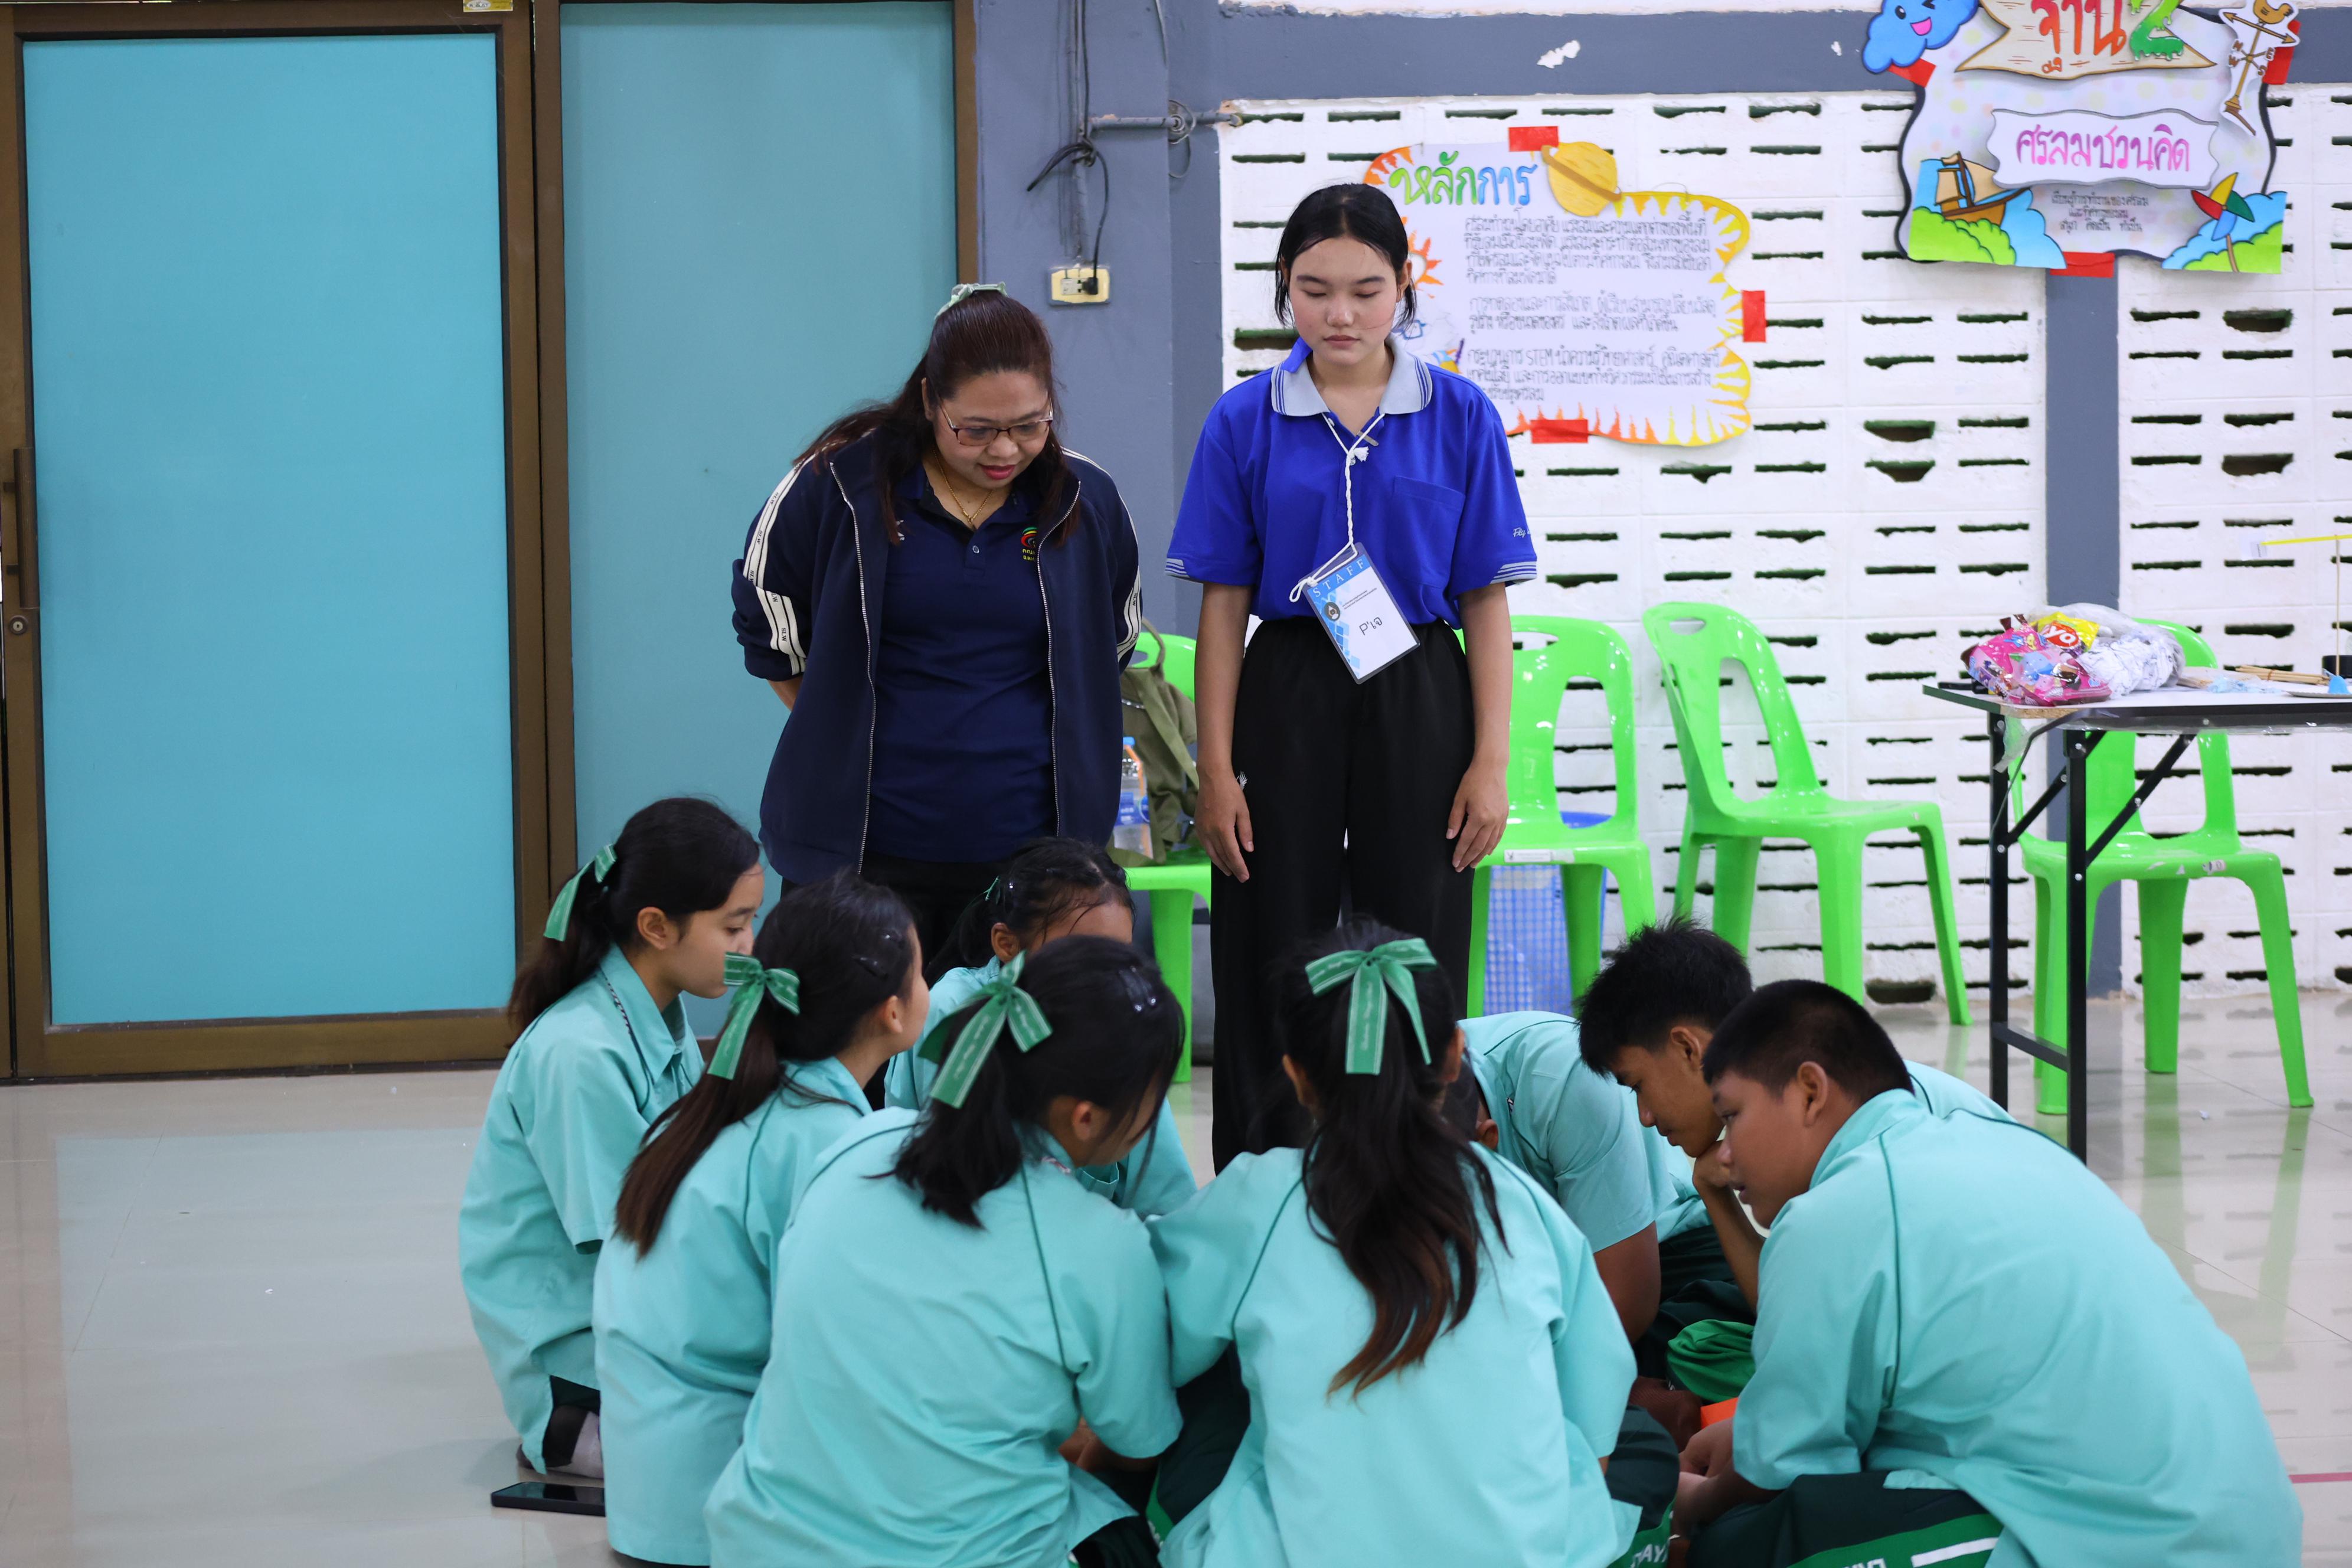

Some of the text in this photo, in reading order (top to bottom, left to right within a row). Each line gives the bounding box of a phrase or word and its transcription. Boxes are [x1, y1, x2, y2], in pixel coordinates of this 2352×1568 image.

[2016, 123, 2190, 172] ศรลมชวนคิด
[1389, 151, 1538, 206] หลักการ
[1525, 349, 1554, 366] STEM
[1312, 559, 1365, 597] STAFF
